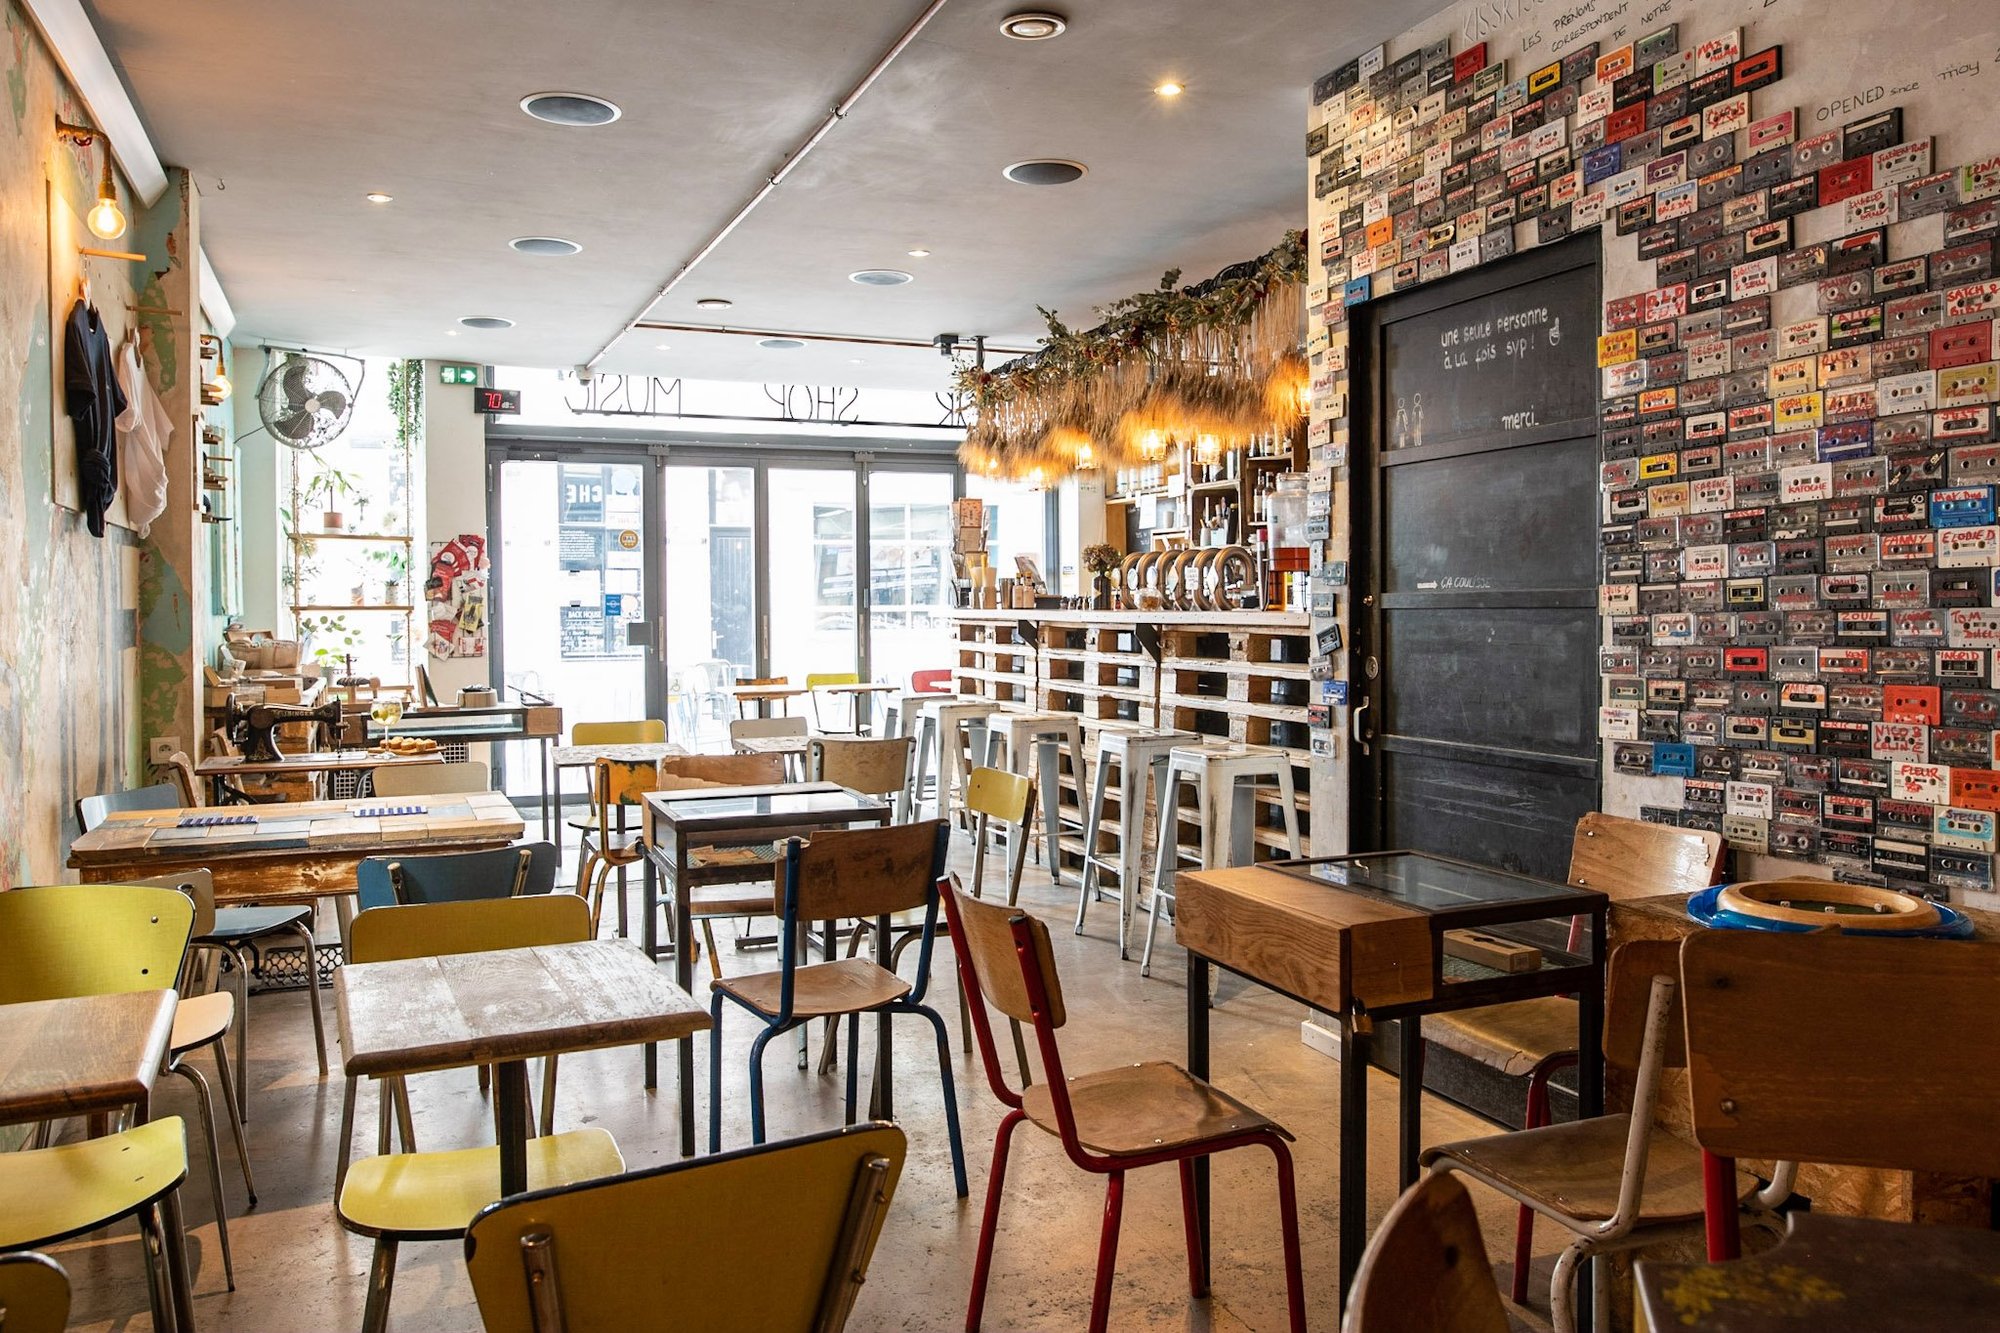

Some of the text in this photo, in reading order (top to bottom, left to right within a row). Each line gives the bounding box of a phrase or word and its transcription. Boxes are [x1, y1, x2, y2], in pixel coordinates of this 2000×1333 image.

[1551, 2, 1629, 53] CORRESPONDENT
[1613, 0, 1673, 42] DE NOTRE
[1522, 31, 1542, 52] LES
[1816, 86, 1885, 121] OPENED
[1890, 82, 1920, 96] since
[1946, 285, 1985, 303] SATCH
[1441, 307, 1549, 347] une seule personne
[1444, 351, 1452, 370] à
[1476, 345, 1496, 371] fois
[1506, 337, 1527, 359] svp
[1690, 342, 1726, 358] HELENA
[485, 392, 503, 409] 70
[1945, 387, 1966, 398] FLO
[1911, 494, 1924, 504] 60
[1883, 534, 1929, 547] FANNY
[1942, 529, 1996, 544] ELODIE D
[1951, 608, 1982, 624] TOM
[1940, 651, 1979, 660] INGRID
[1875, 725, 1908, 738] NICO
[1901, 765, 1943, 782] FLEUR
